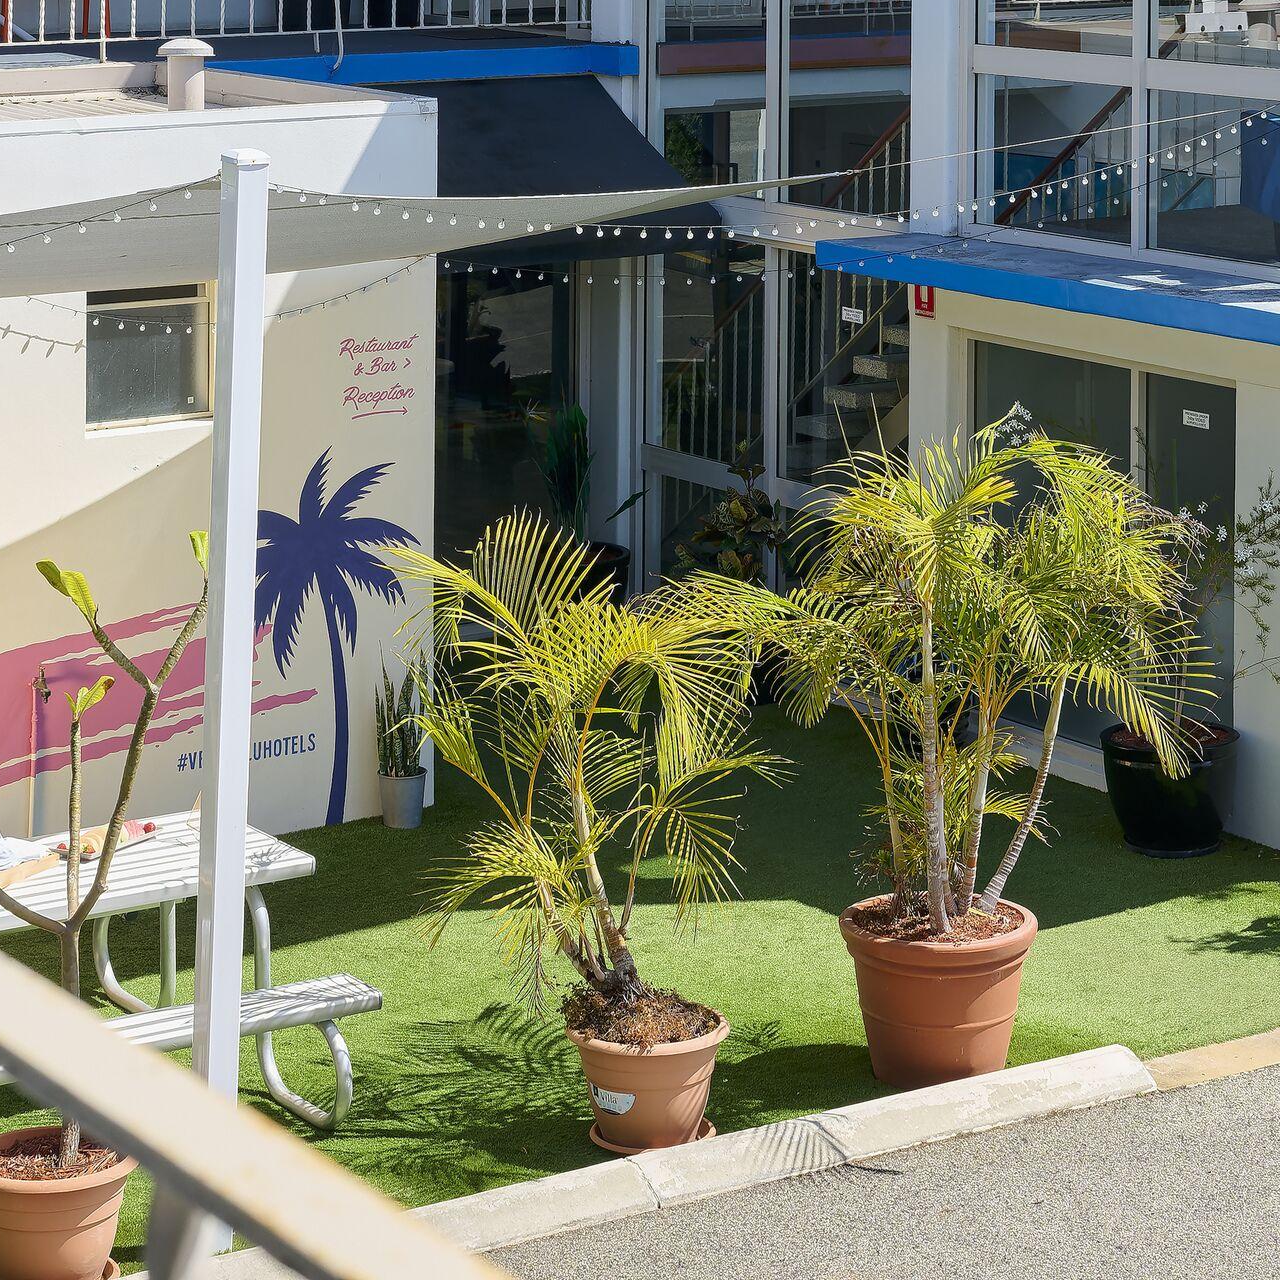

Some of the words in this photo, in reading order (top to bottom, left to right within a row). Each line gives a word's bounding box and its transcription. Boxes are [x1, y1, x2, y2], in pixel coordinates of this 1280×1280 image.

[339, 333, 420, 361] Restaurant
[353, 362, 365, 376] &
[365, 356, 398, 376] Bar
[342, 382, 416, 411] Reception
[177, 733, 317, 772] #VUHOTELS
